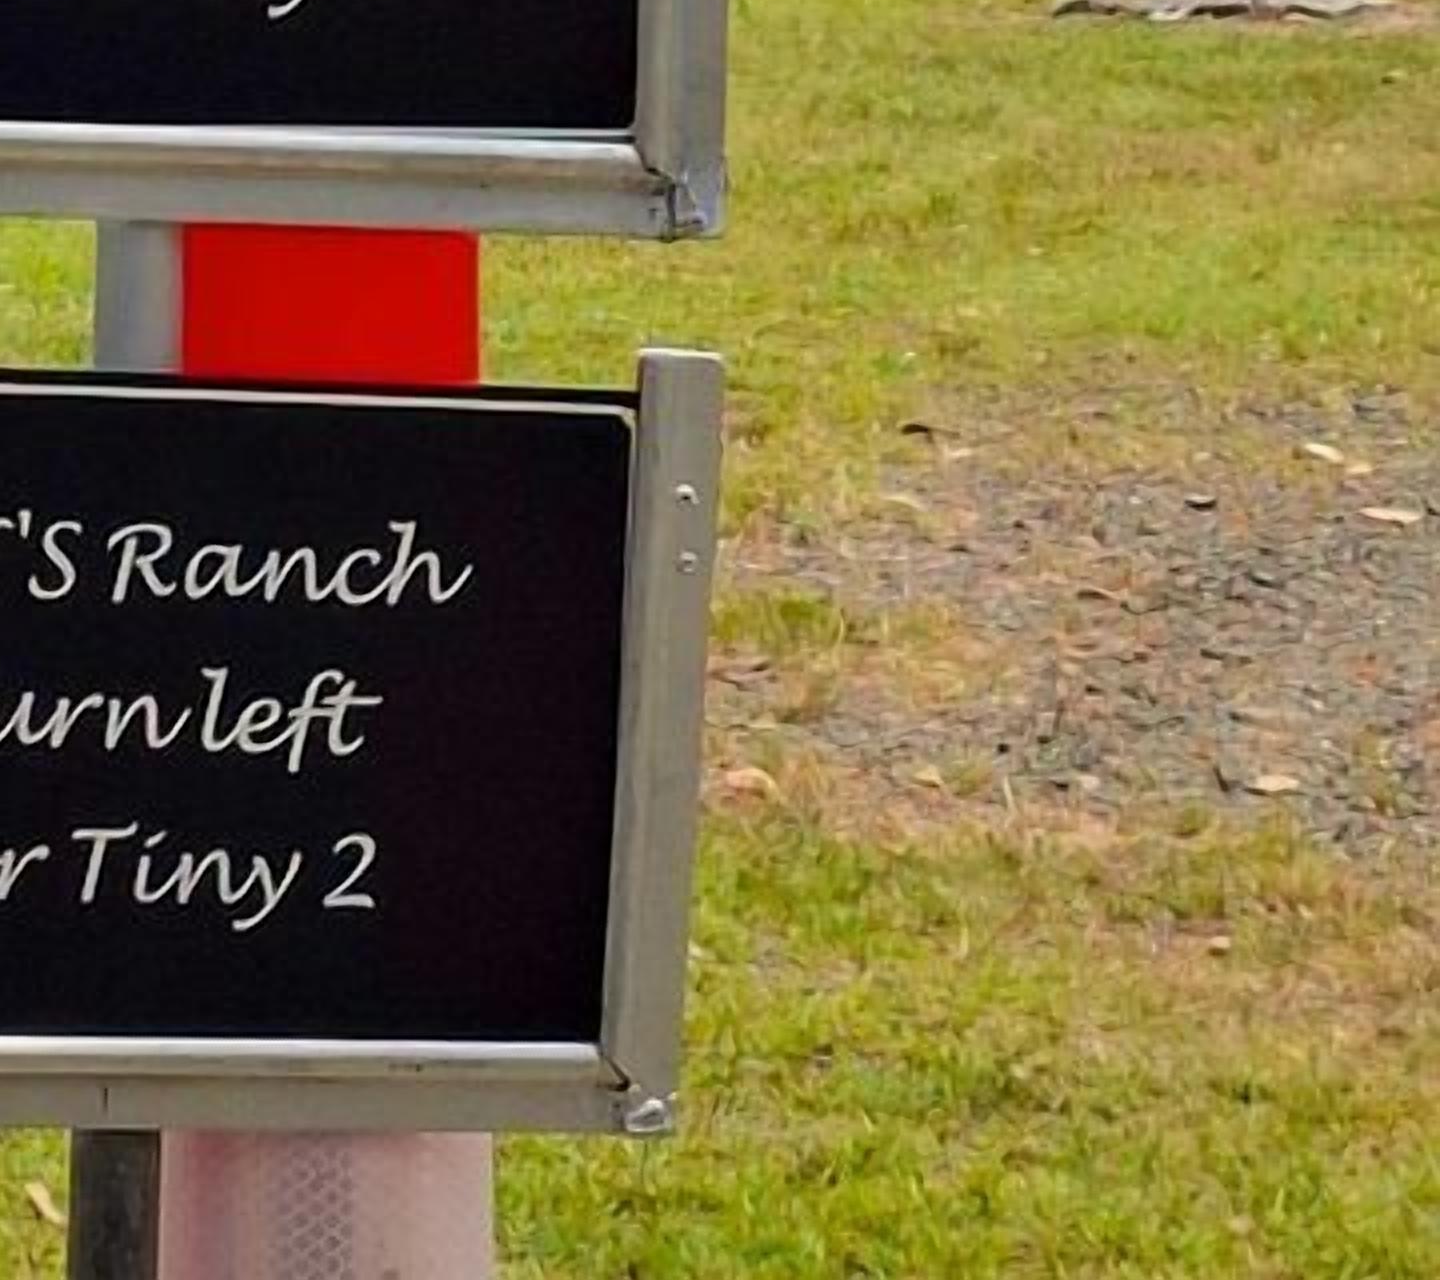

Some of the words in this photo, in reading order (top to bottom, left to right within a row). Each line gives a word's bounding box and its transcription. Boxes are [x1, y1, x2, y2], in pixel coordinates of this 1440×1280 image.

[106, 520, 474, 606] Ranch
[200, 666, 384, 774] left
[70, 821, 302, 932] Tiny
[322, 833, 377, 909] 2
